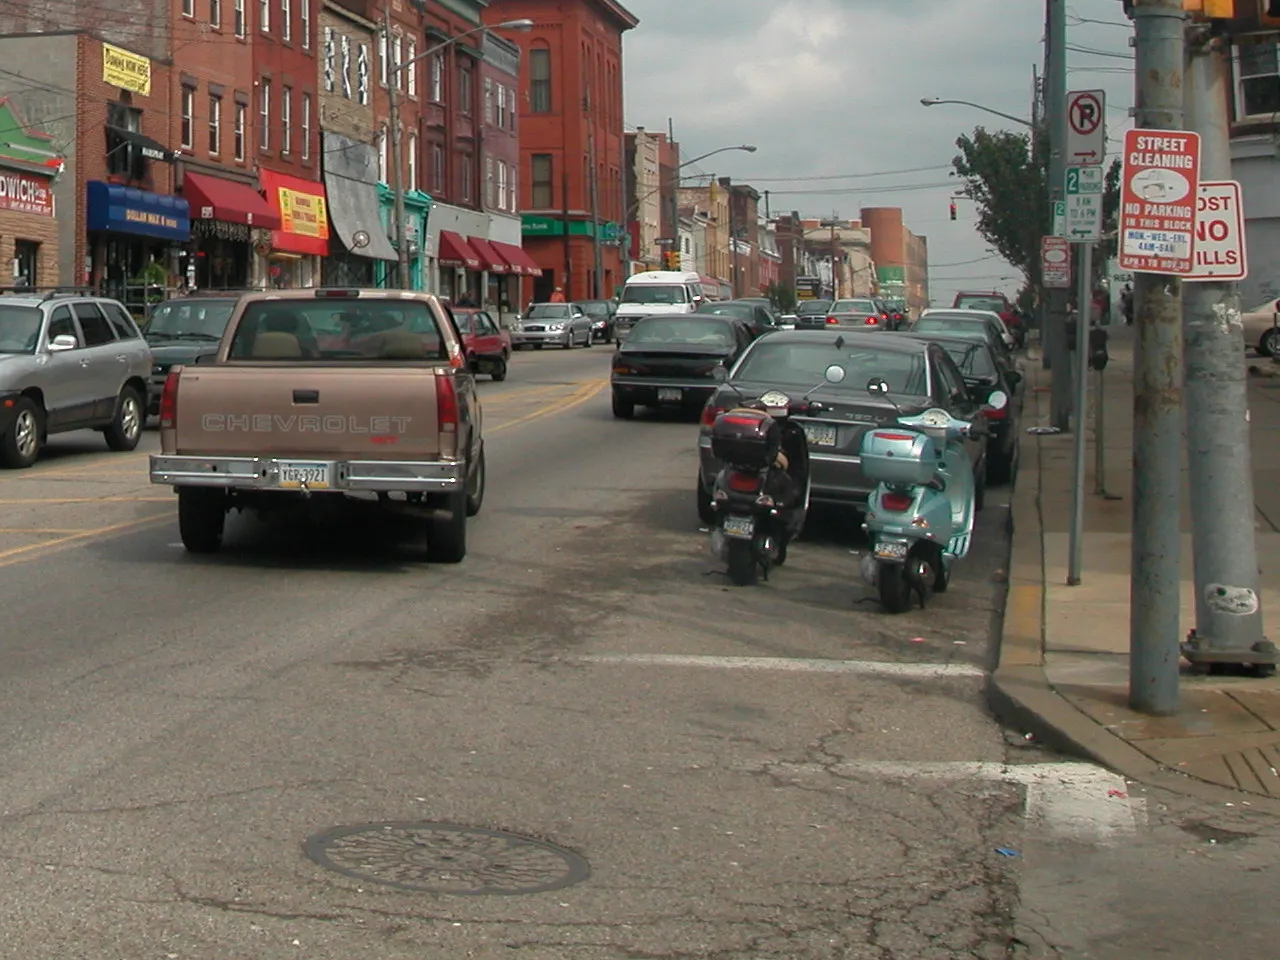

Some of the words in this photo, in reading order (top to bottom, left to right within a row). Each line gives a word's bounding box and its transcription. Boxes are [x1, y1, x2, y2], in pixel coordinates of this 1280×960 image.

[1136, 136, 1187, 152] STREET
[1130, 152, 1193, 169] CLEANING
[1068, 173, 1078, 191] 2
[1125, 202, 1140, 215] NO
[1144, 204, 1192, 218] PARKING
[1198, 197, 1231, 212] OST
[1140, 218, 1160, 228] THIS
[1164, 220, 1192, 231] BLOCK
[1197, 250, 1237, 266] ILLS
[201, 413, 412, 434] CHEVROLET
